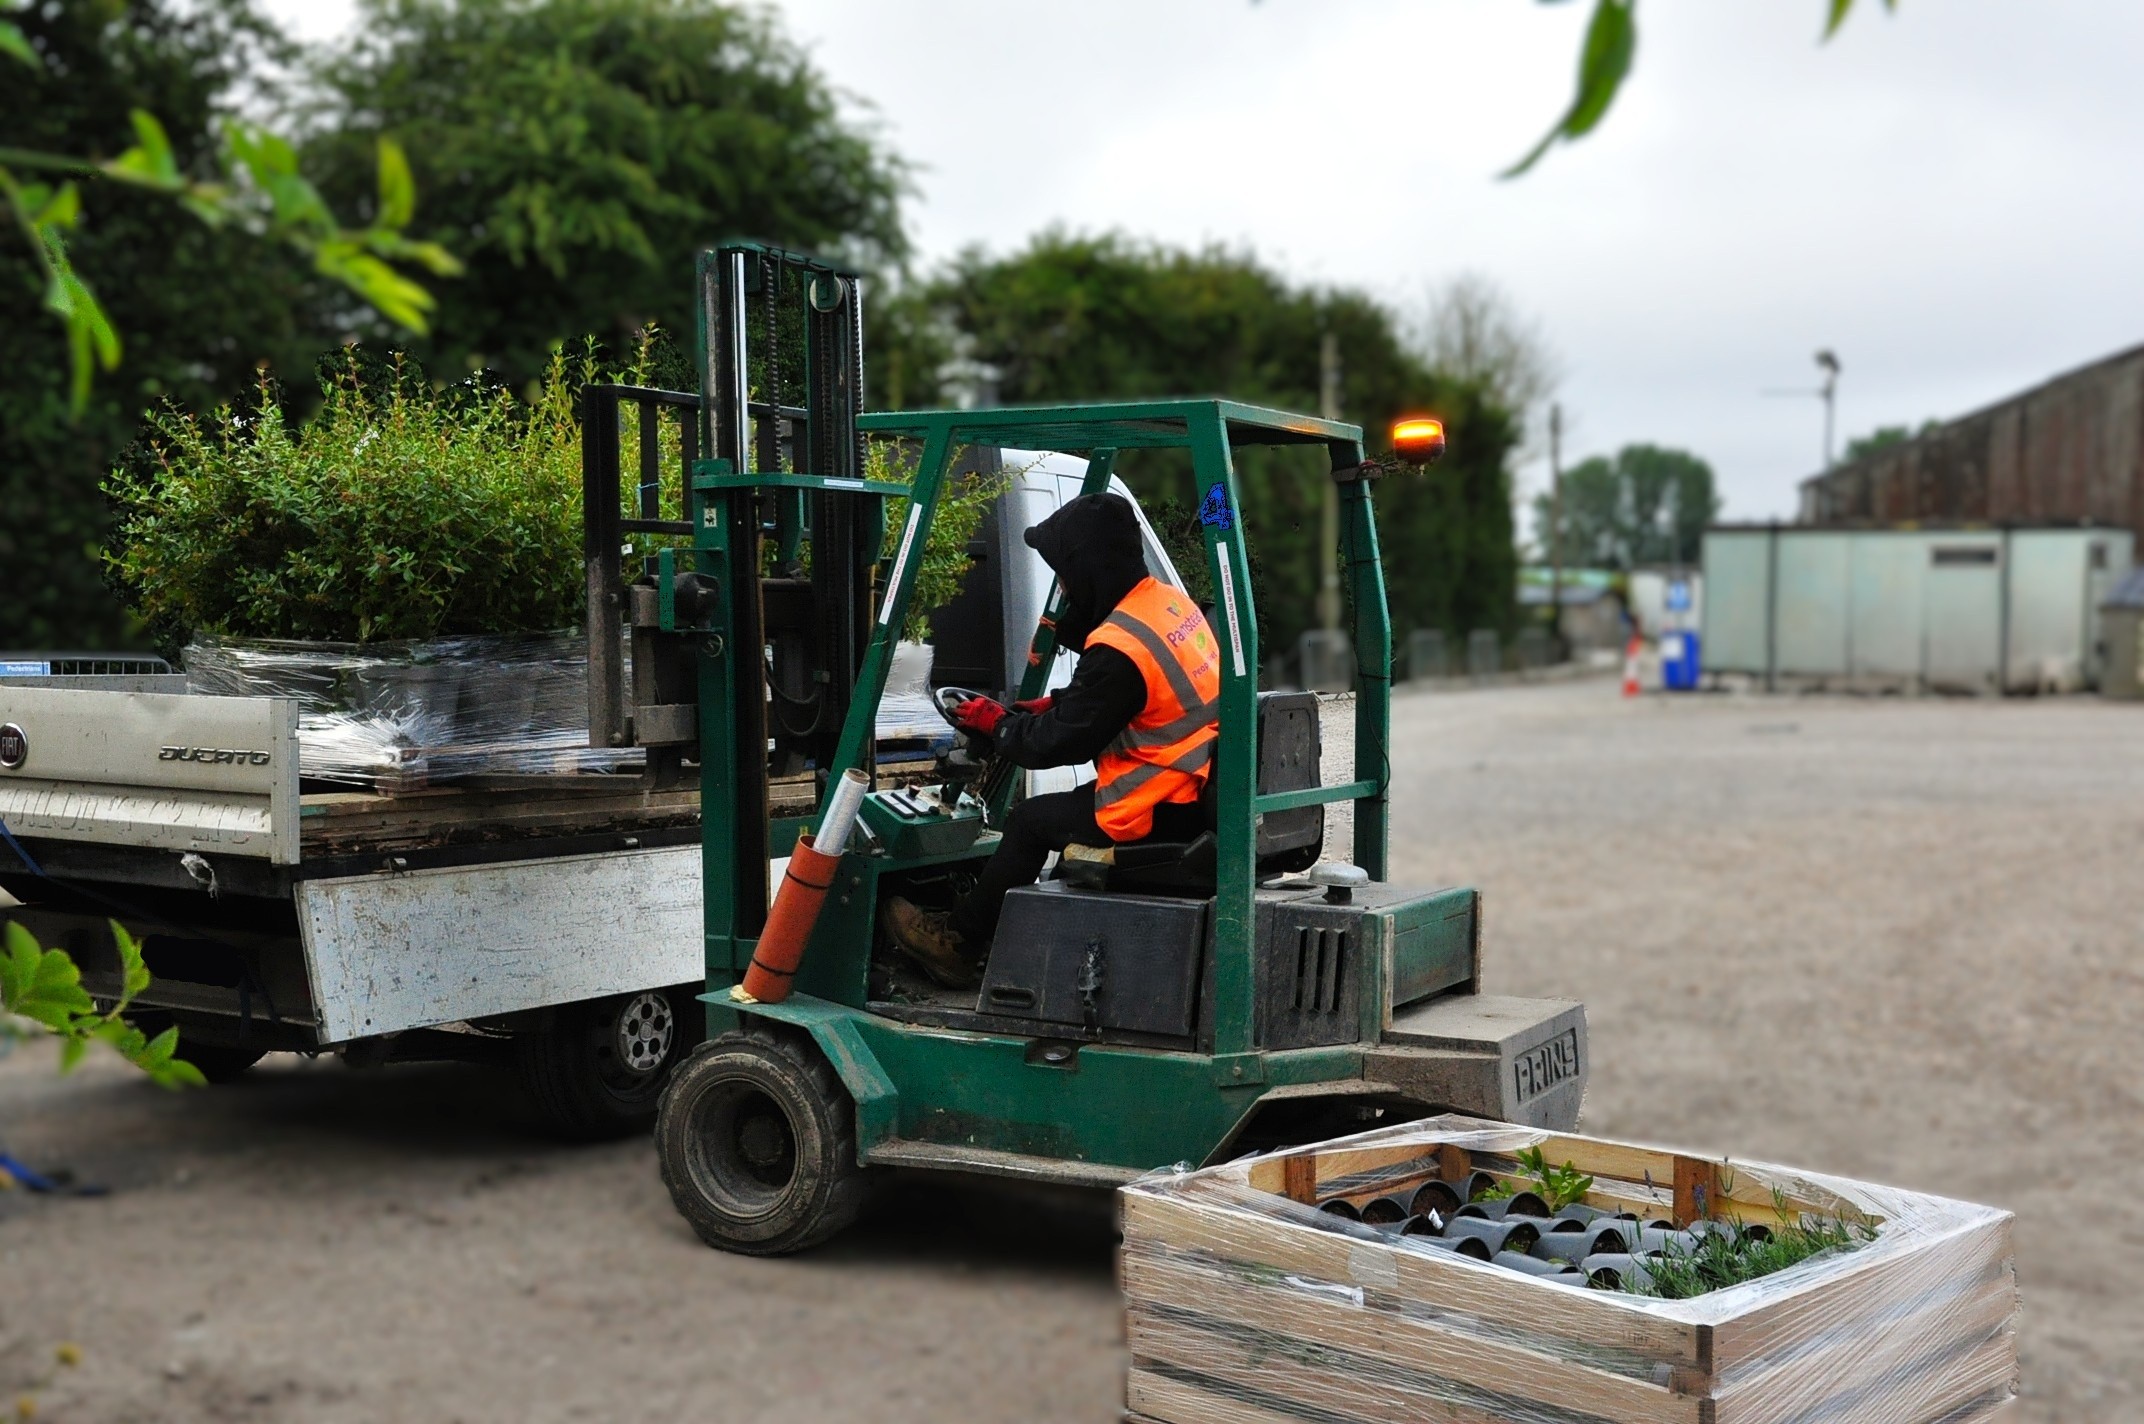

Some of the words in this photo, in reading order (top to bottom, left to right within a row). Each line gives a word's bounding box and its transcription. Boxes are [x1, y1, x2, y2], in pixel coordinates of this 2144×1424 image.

[1199, 481, 1235, 530] 4
[1223, 564, 1229, 574] DO
[1232, 622, 1241, 653] MULTISPAN
[2, 736, 19, 756] FIAT
[159, 745, 271, 766] DUCATO
